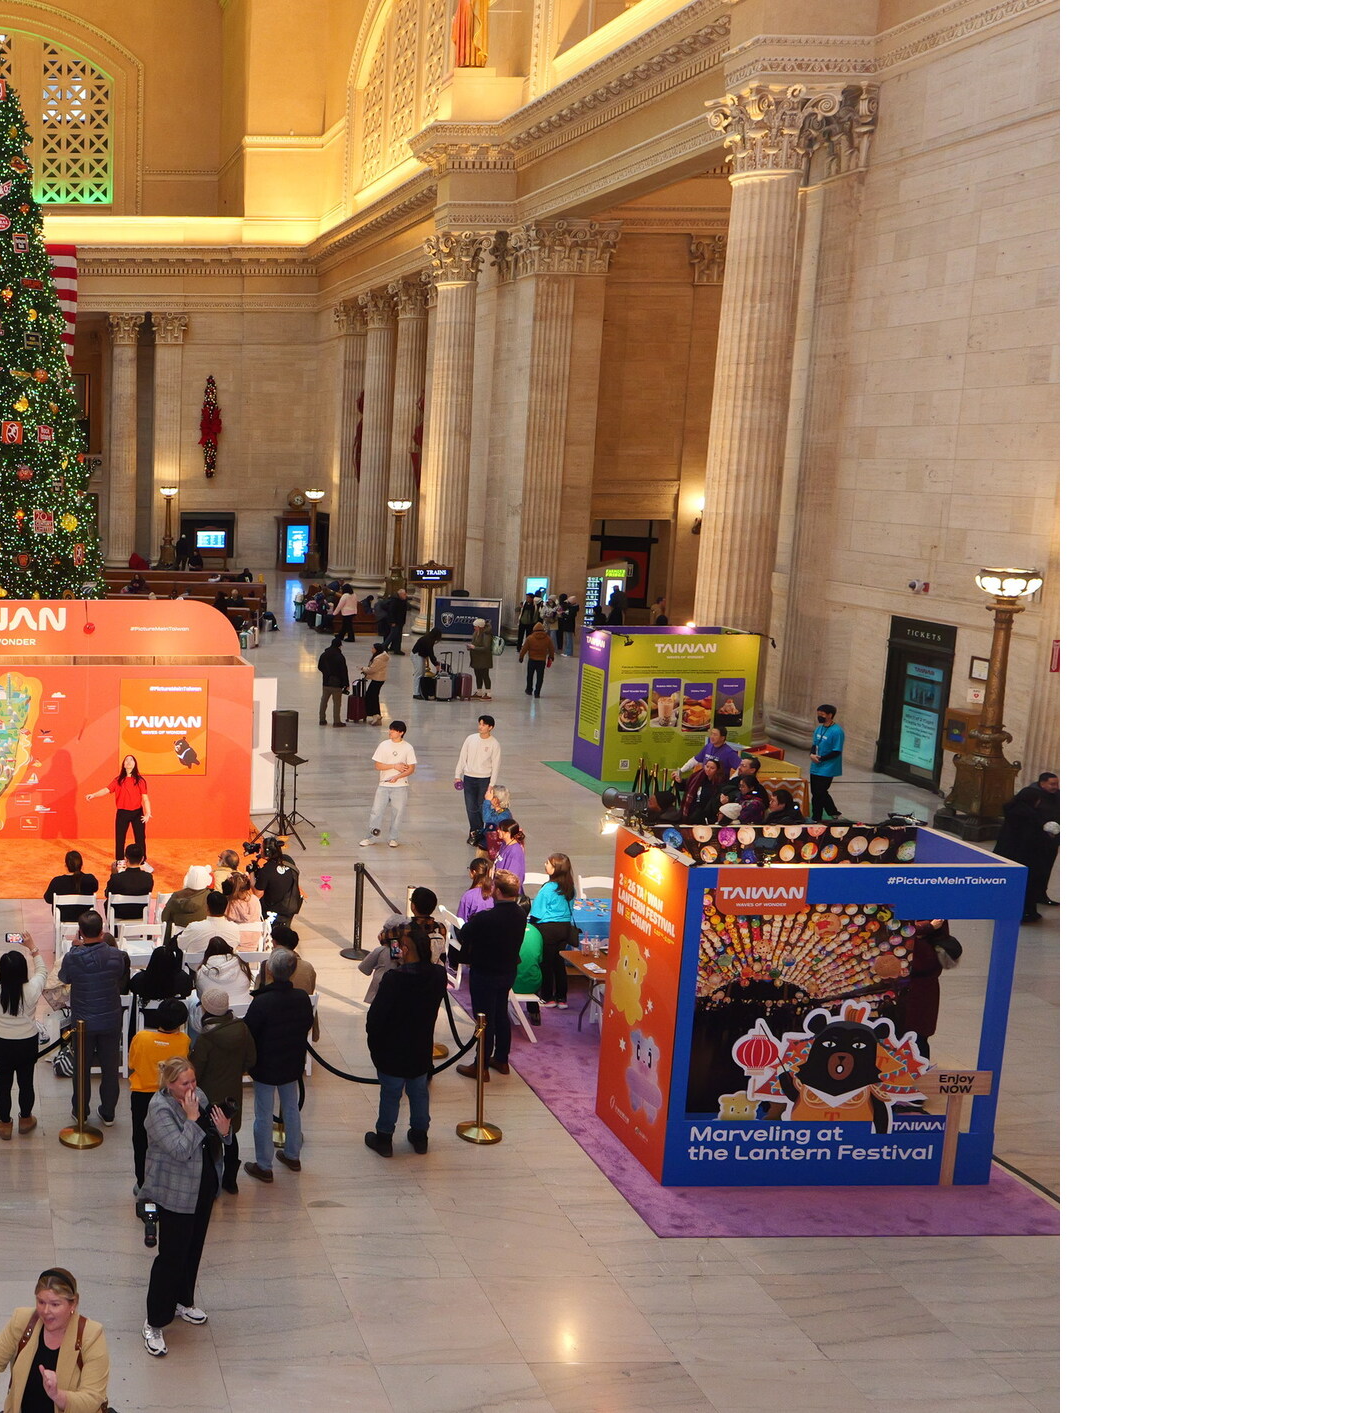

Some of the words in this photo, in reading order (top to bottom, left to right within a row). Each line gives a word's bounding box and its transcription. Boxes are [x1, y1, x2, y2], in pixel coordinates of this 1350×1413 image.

[907, 629, 942, 641] TICKETS
[586, 636, 606, 648] TAIWAN
[655, 643, 716, 654] TAIWAN
[126, 716, 201, 728] TAIWAN
[887, 876, 1007, 885] #PictureMeInTaiwan
[636, 883, 664, 912] TAIWAN
[720, 886, 804, 899] TAIWAN
[618, 886, 646, 917] LANTERN
[646, 906, 675, 938] FESTIVAL
[617, 902, 624, 916] IN
[630, 910, 652, 936] CHIAYI
[939, 1074, 974, 1086] Enjoy
[940, 1085, 972, 1094] NOW
[892, 1122, 945, 1130] TAIWA
[690, 1126, 812, 1145] Marveling
[817, 1128, 843, 1142] at
[688, 1145, 729, 1160] the
[735, 1146, 831, 1160] Lantern
[838, 1145, 933, 1160] Festival
